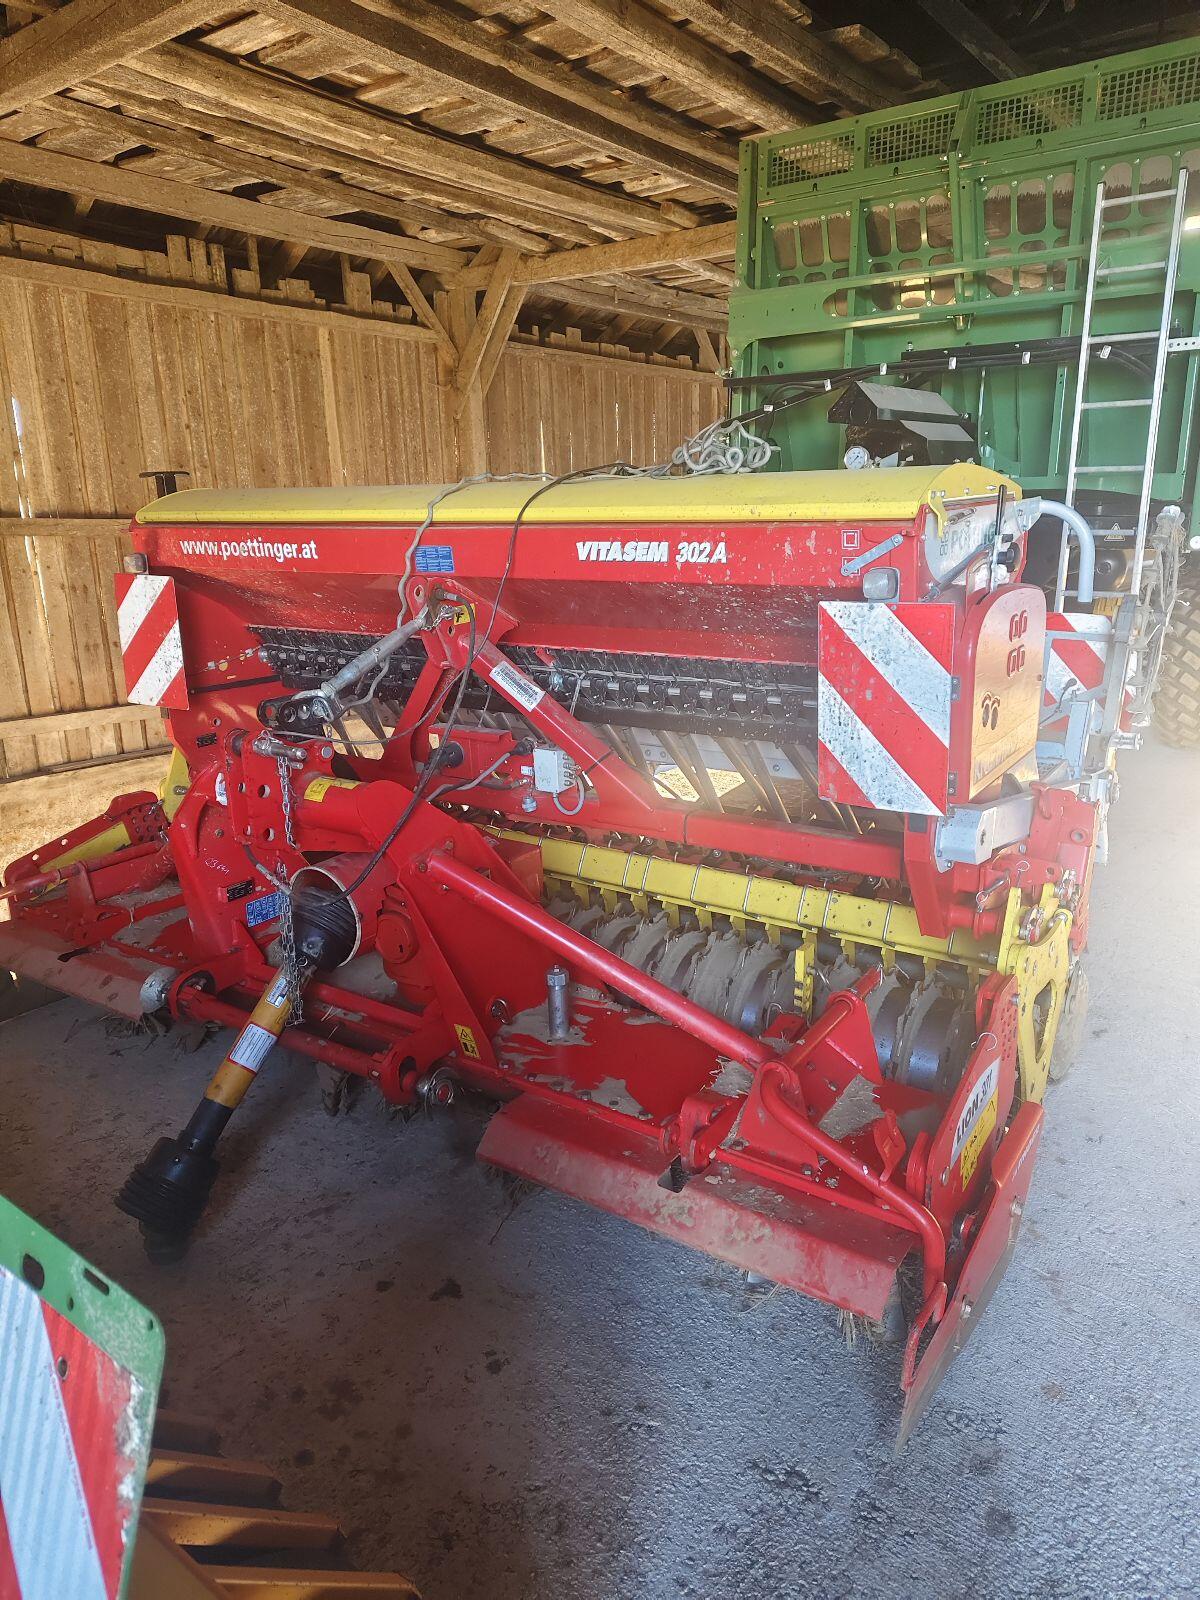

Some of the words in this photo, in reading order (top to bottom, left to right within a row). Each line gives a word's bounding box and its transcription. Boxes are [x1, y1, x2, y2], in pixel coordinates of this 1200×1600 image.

[179, 537, 319, 563] www.poettinger.at
[575, 541, 669, 562] VITASEM
[956, 1093, 979, 1144] LION
